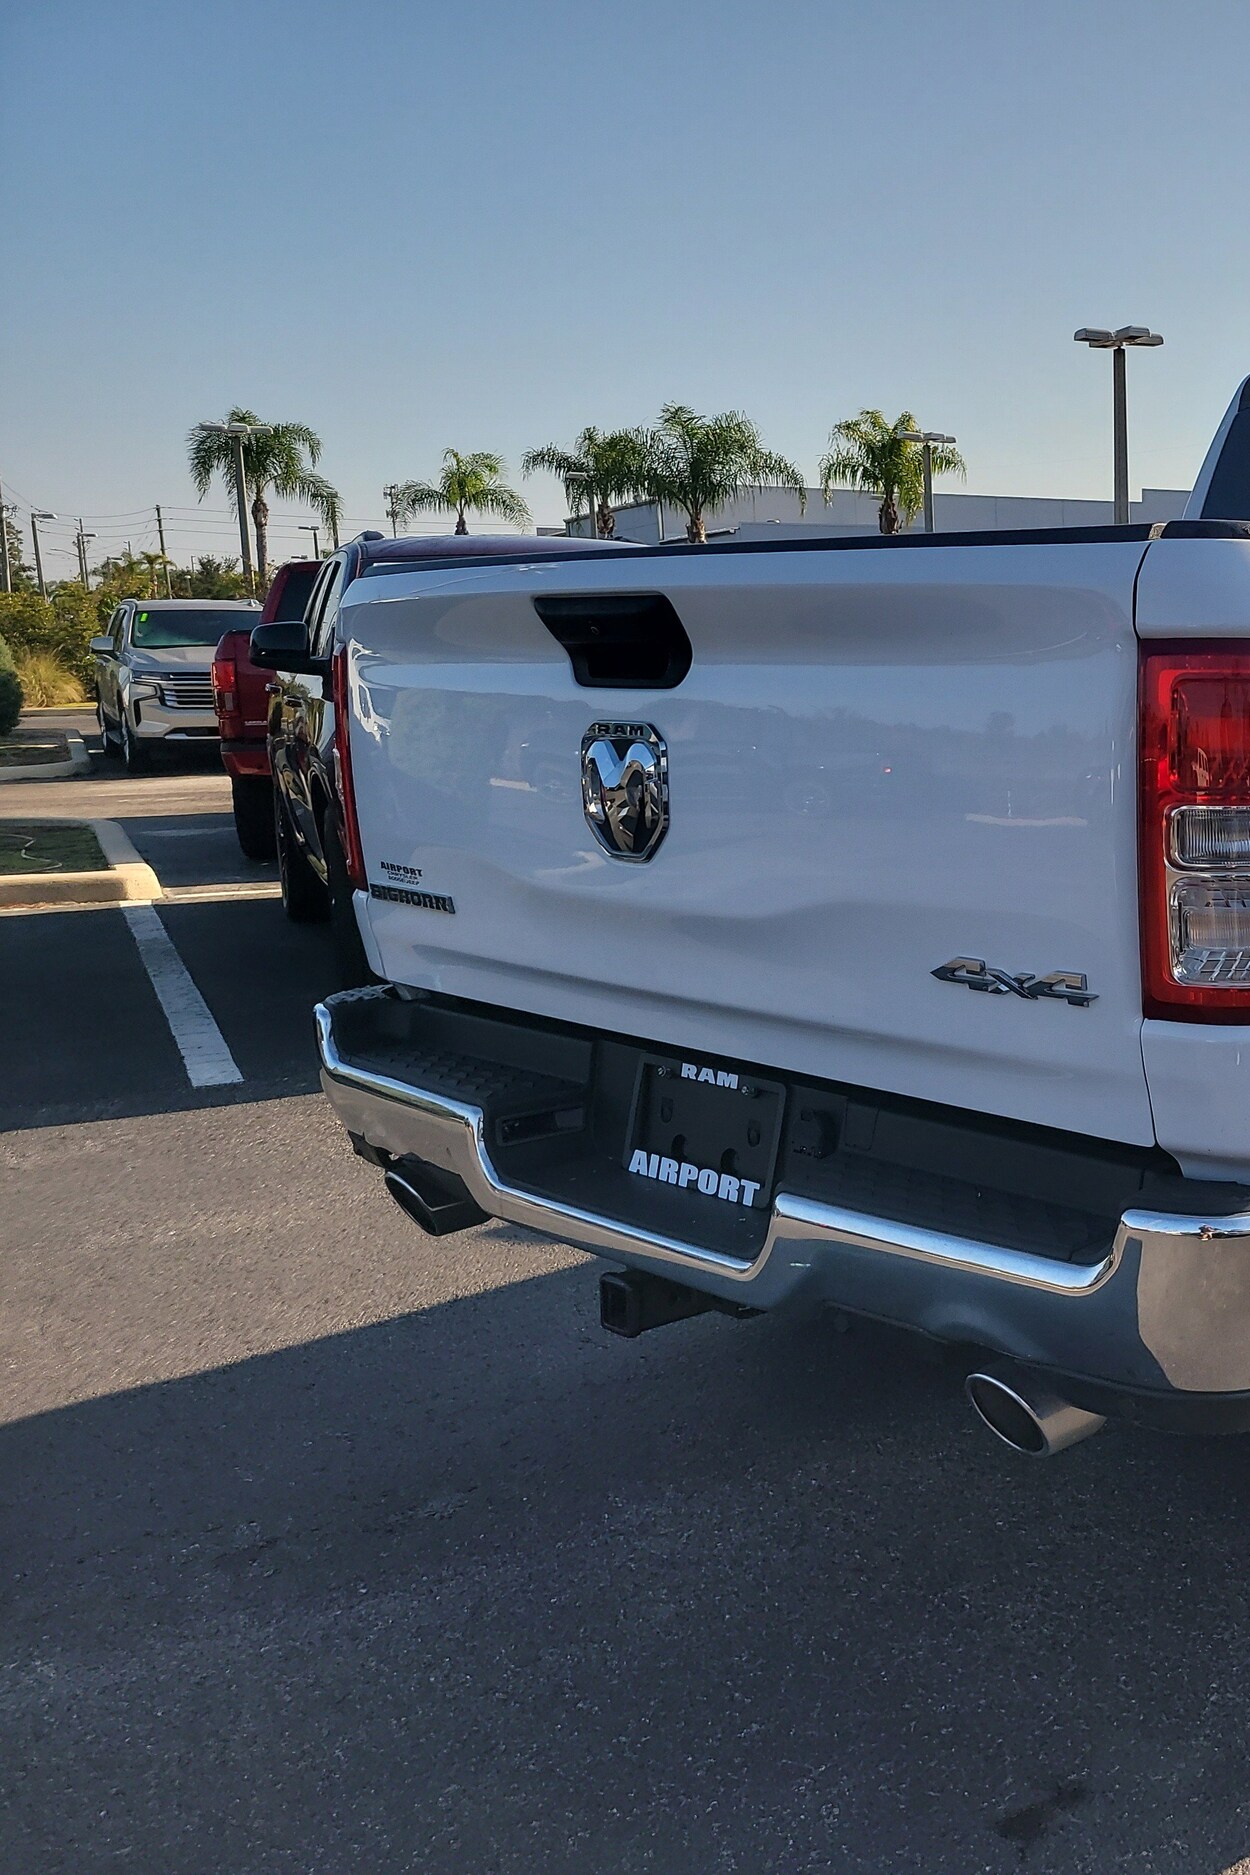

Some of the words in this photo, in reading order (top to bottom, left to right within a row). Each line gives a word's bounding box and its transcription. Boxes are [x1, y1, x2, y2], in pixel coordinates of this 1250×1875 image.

[594, 724, 645, 737] RAM
[380, 860, 423, 877] AIRPORT
[680, 1062, 740, 1090] RAM
[628, 1149, 761, 1207] AIRPORT
